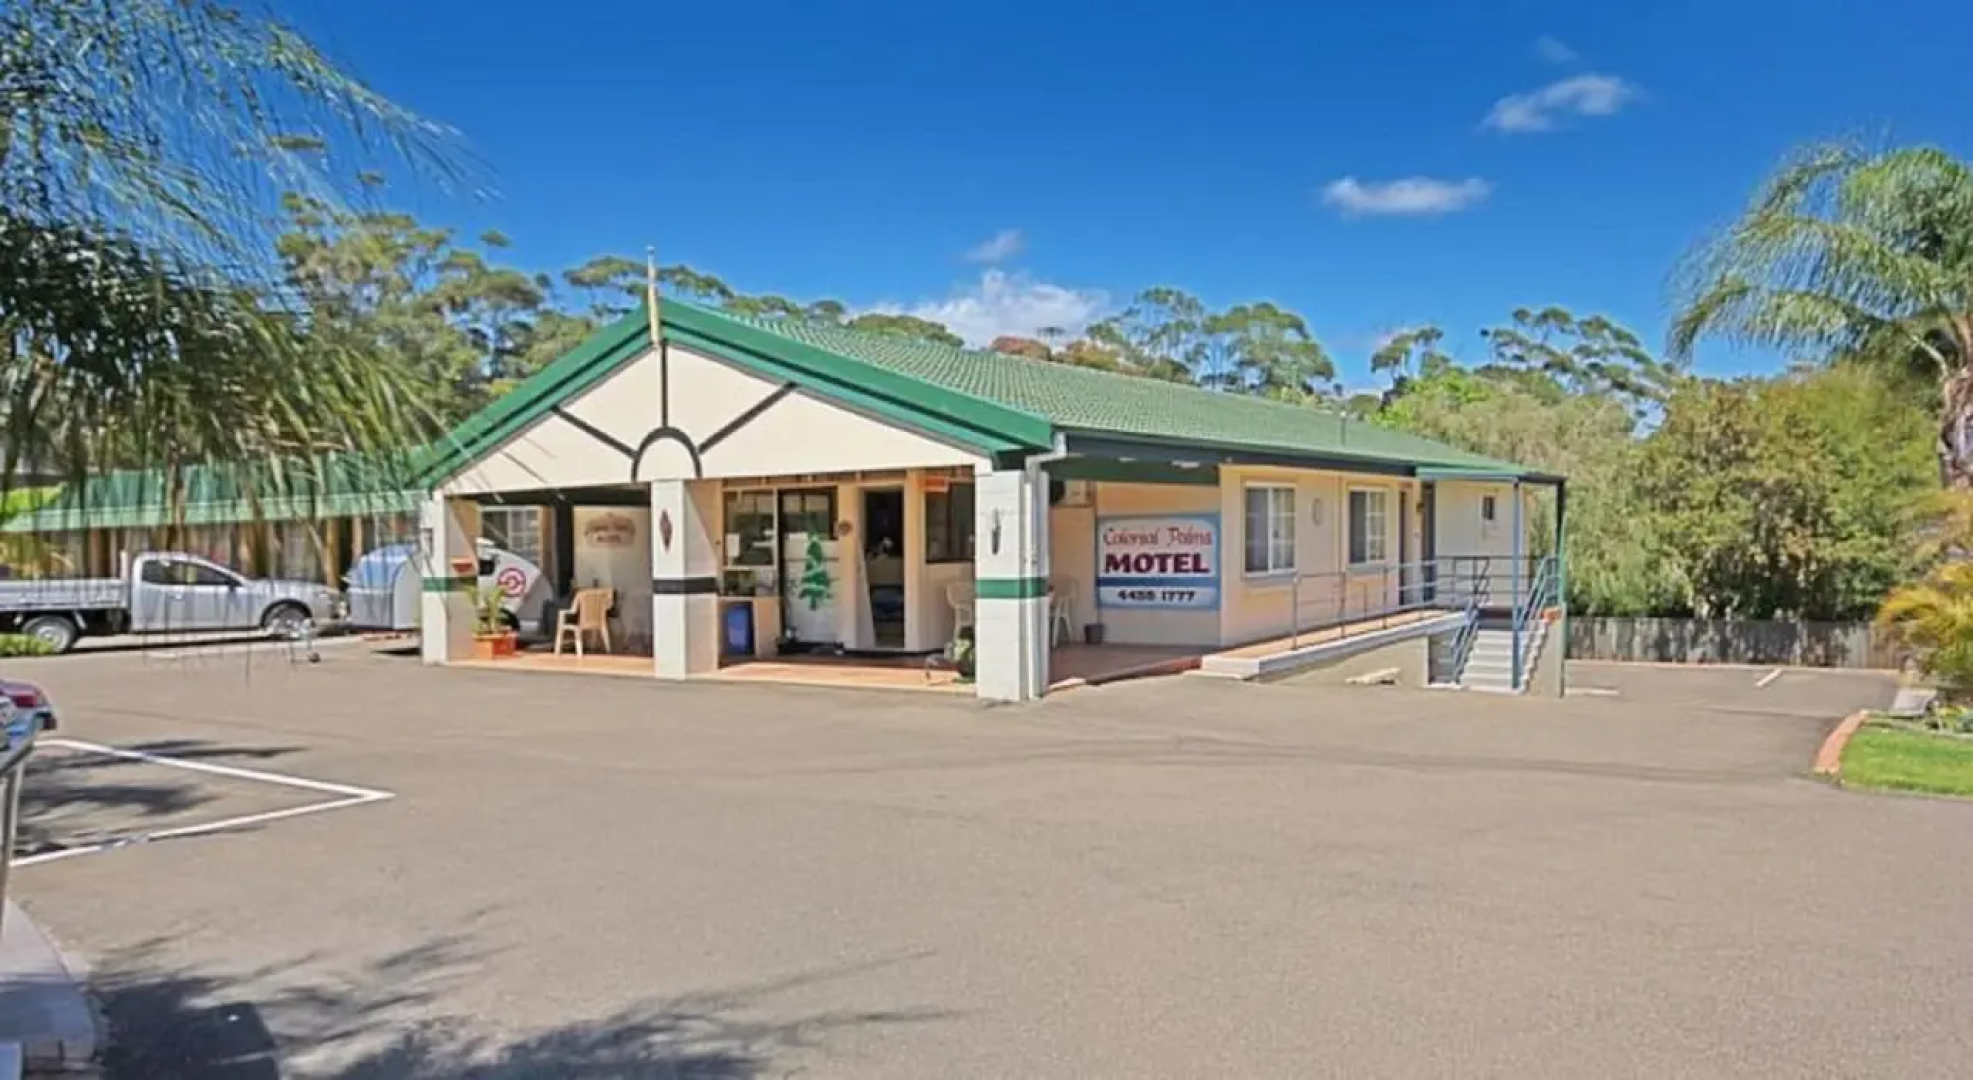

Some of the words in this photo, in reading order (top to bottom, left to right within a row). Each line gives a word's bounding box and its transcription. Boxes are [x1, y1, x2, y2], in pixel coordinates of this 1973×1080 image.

[1166, 524, 1212, 547] Palms
[1105, 552, 1210, 574] MOTEL
[1161, 590, 1196, 602] 1777
